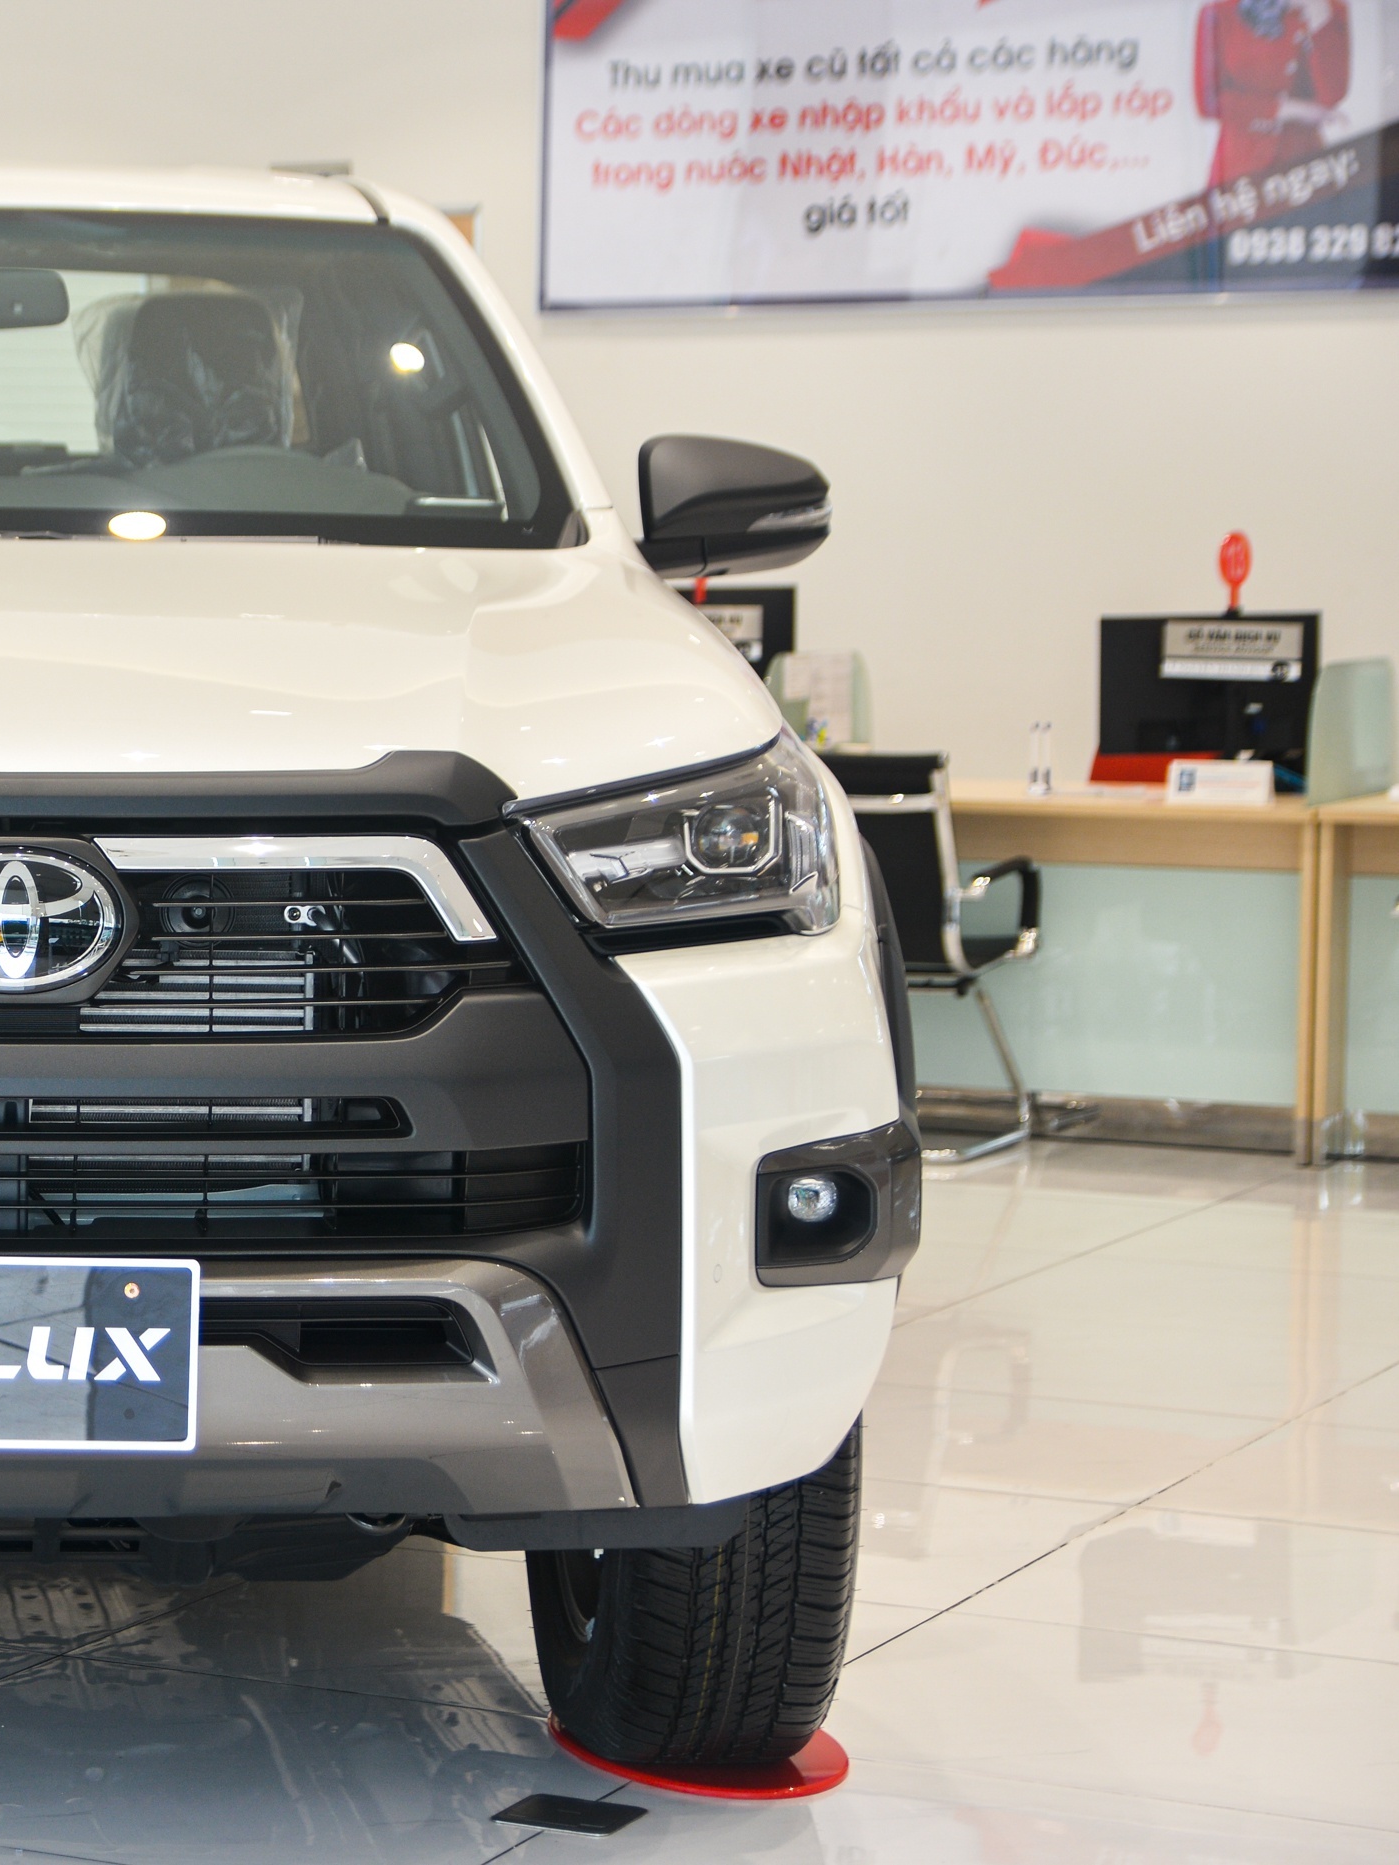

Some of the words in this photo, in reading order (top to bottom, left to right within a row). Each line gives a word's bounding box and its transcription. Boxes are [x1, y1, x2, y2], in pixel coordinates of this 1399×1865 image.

[609, 58, 661, 88] Thu
[671, 58, 746, 87] mua
[754, 56, 795, 84] xe
[968, 38, 1035, 74] các
[575, 106, 642, 142] Các
[653, 104, 739, 142] dòng
[751, 106, 789, 134] xe
[798, 97, 885, 134] nhập
[993, 88, 1035, 121] và
[593, 157, 675, 195] trong
[803, 193, 857, 236] giá
[868, 189, 909, 224] tốt
[1132, 202, 1208, 253] Liên
[1209, 176, 1257, 223] hệ
